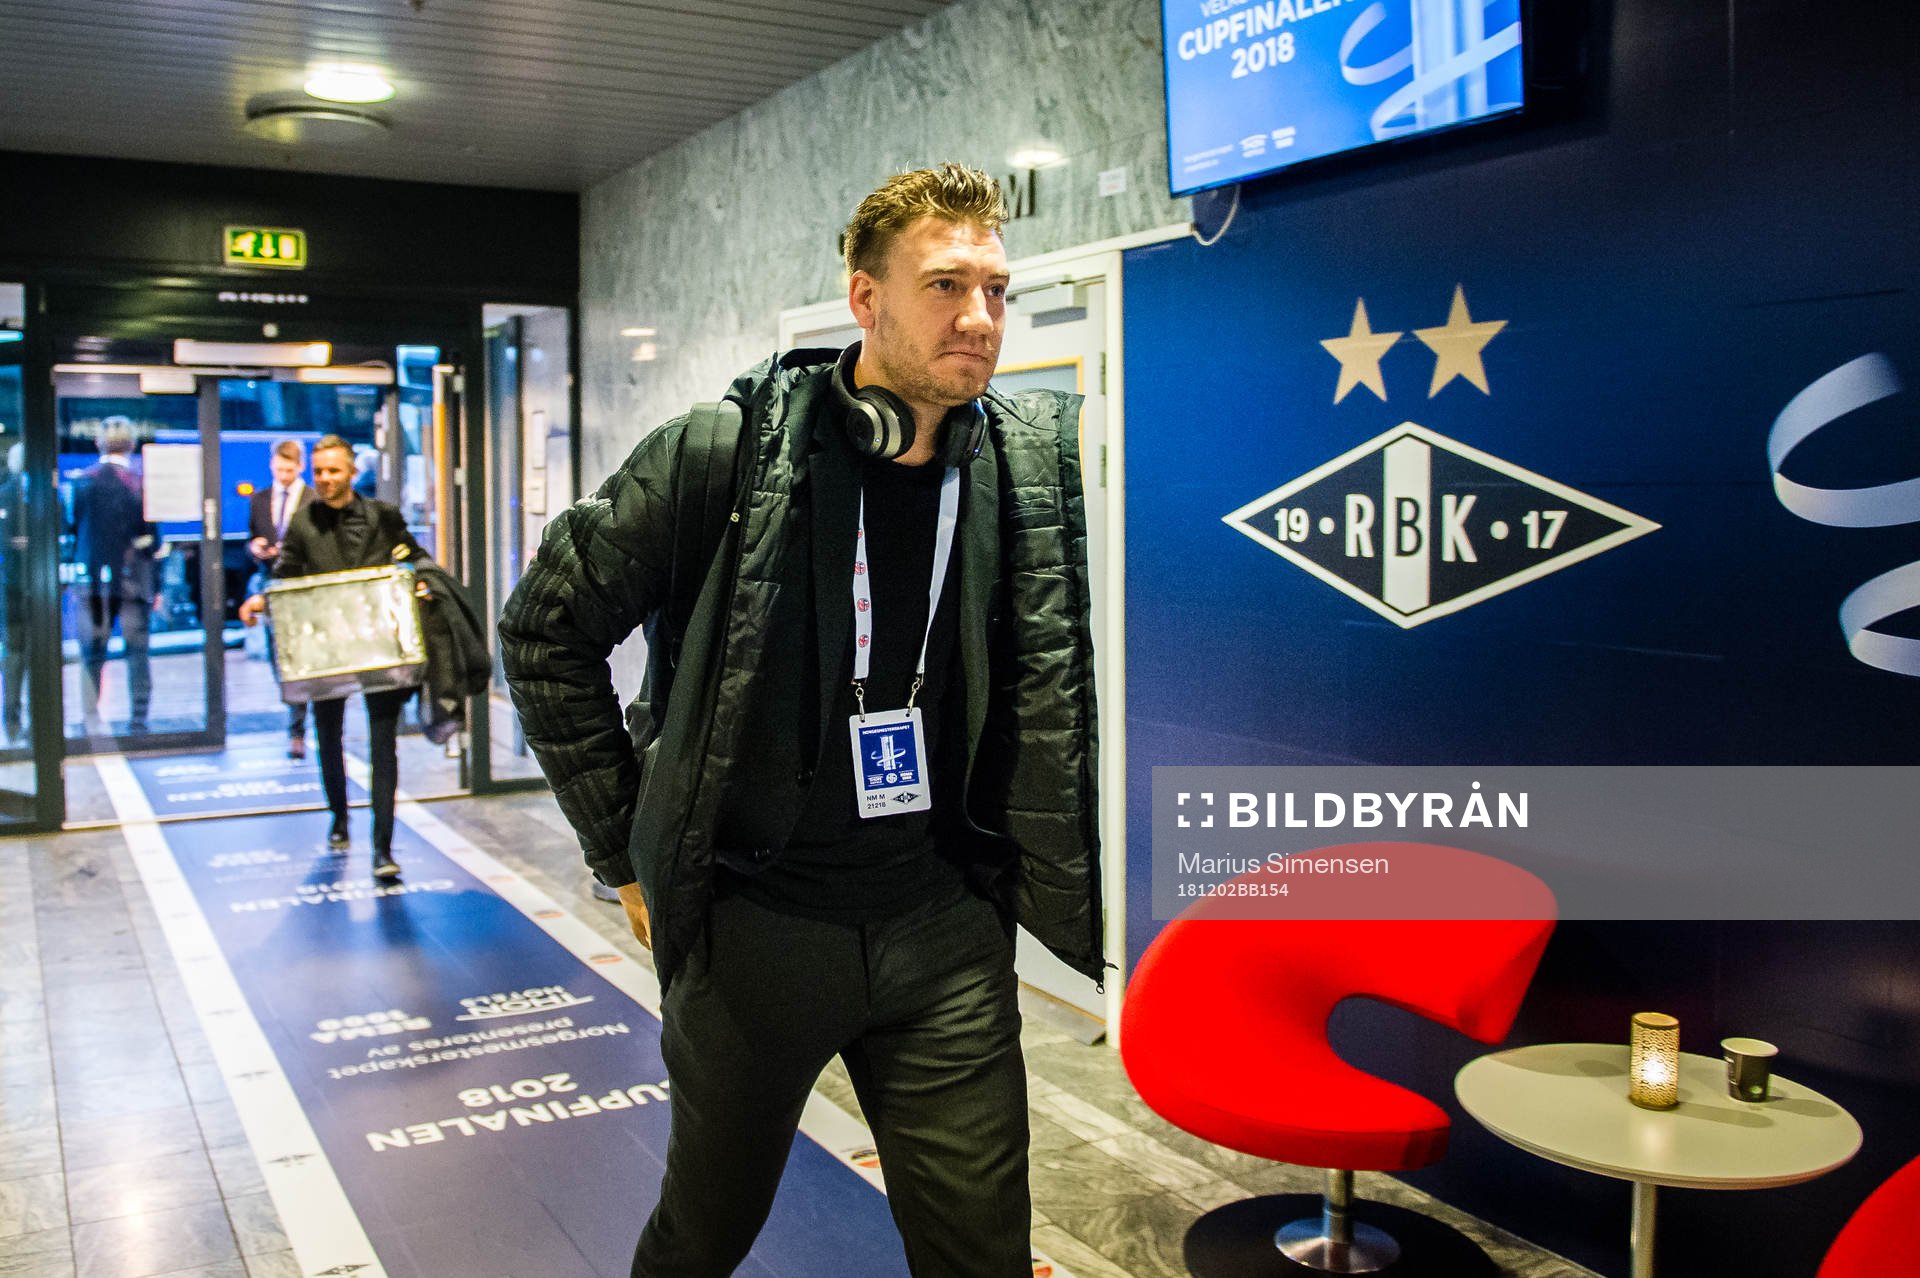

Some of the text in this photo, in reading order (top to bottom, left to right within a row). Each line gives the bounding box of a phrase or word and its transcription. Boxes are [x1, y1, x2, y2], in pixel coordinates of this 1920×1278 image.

[1231, 32, 1295, 79] 2018
[1274, 494, 1568, 563] 19 RBK 17
[456, 992, 594, 1021] THON
[327, 1022, 631, 1080] Norgesmesterskapet
[367, 1016, 574, 1058] presenteres av
[457, 1072, 578, 1108] 2018
[366, 1079, 670, 1152] UPFINALEN
